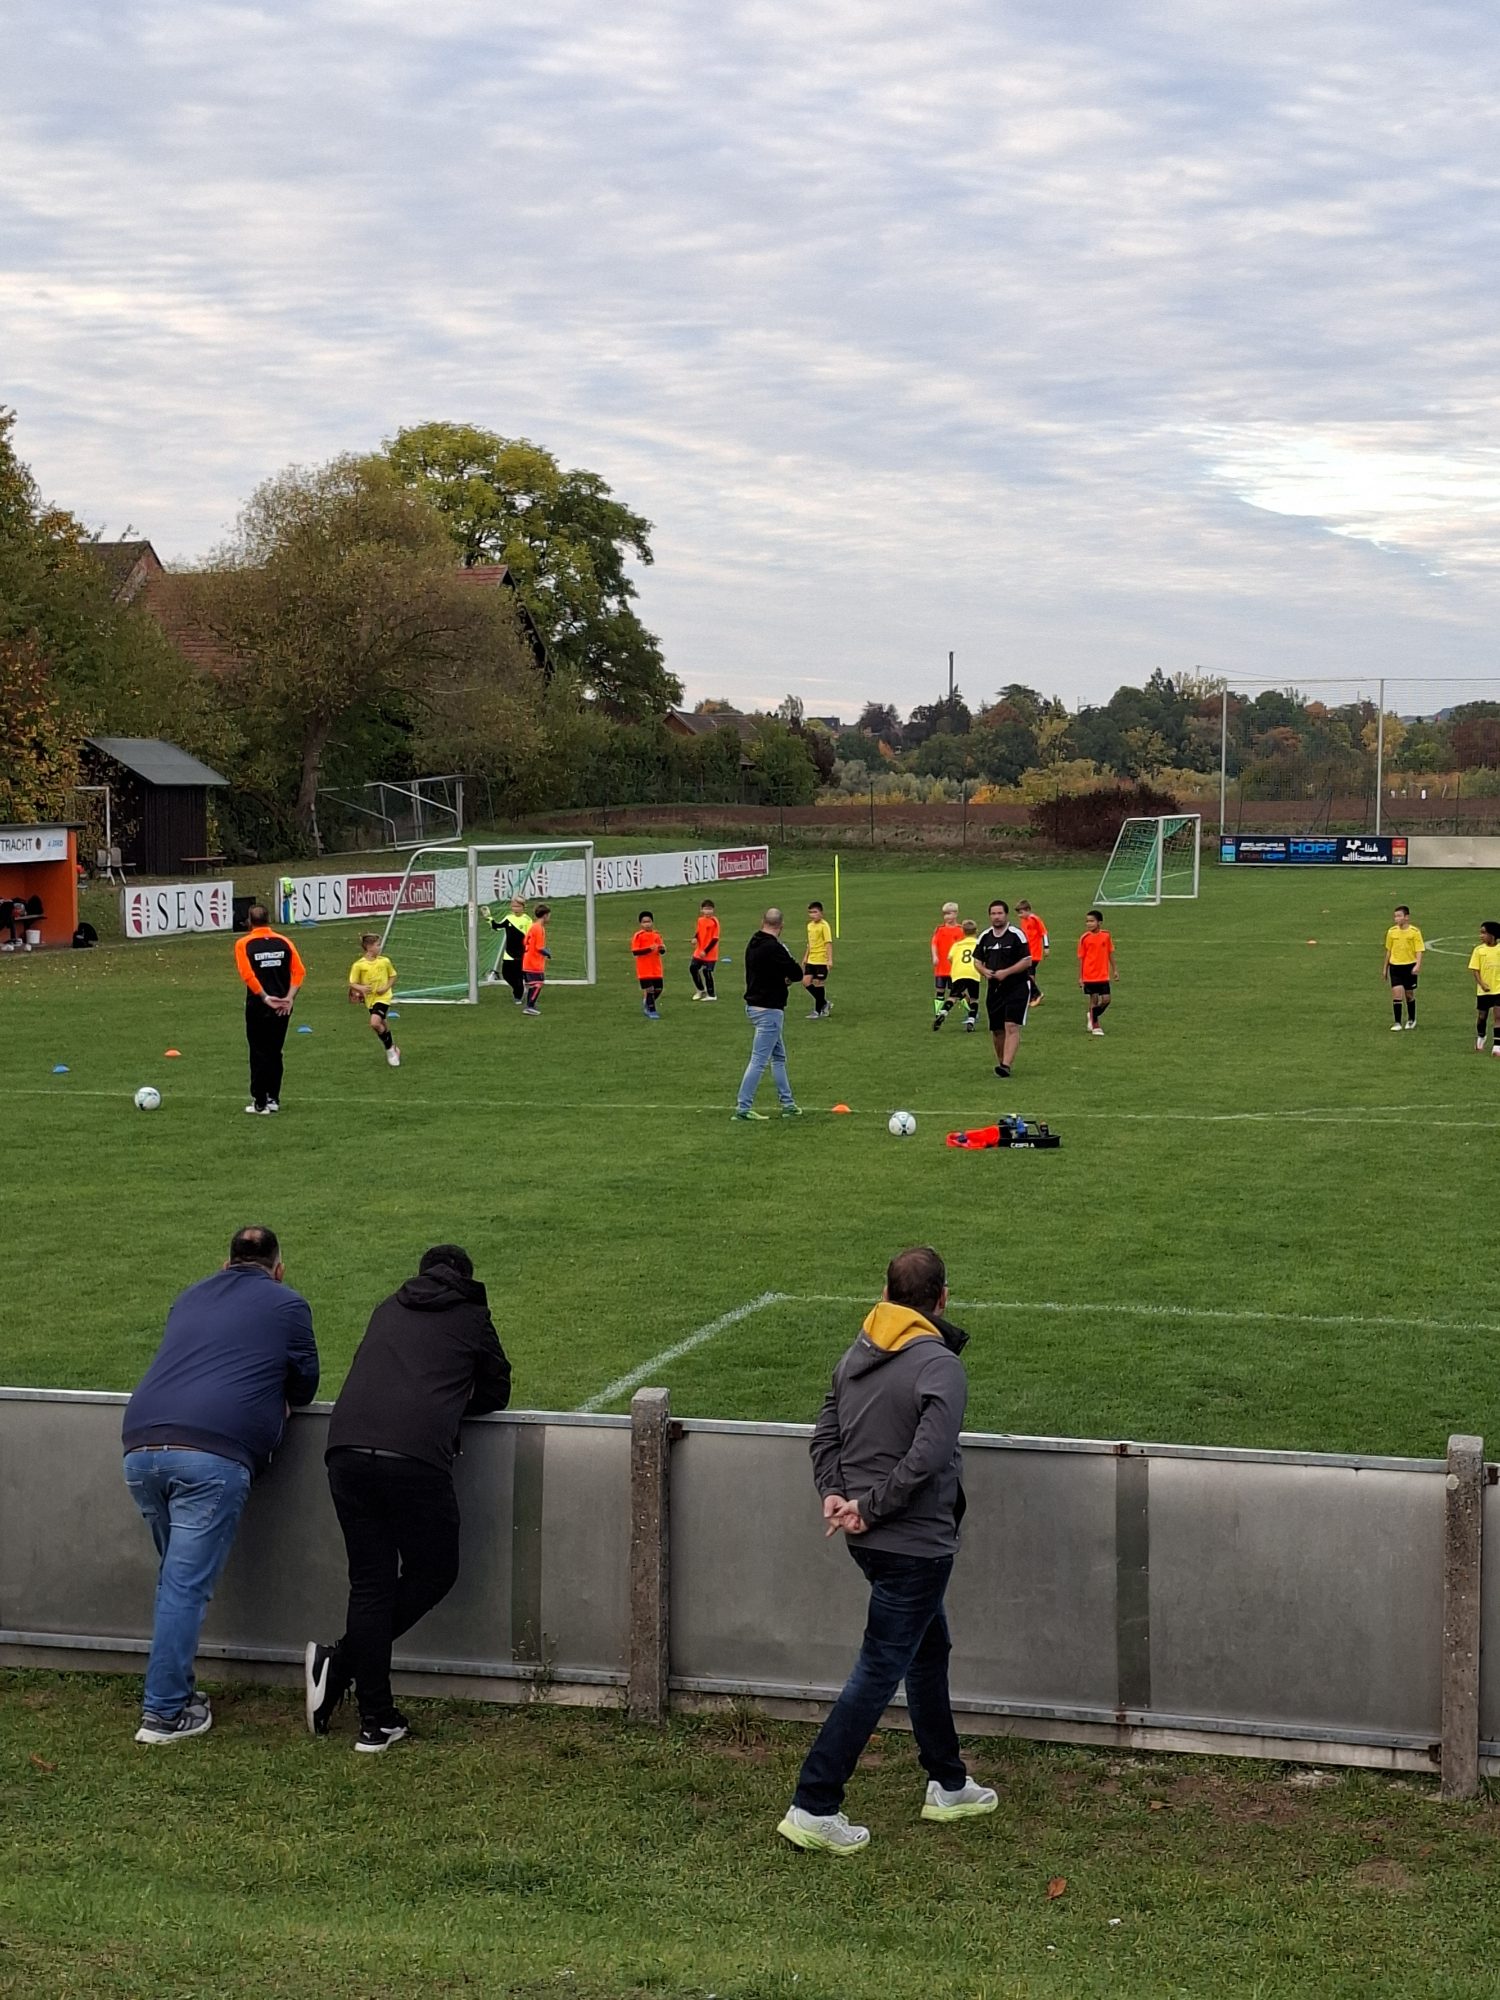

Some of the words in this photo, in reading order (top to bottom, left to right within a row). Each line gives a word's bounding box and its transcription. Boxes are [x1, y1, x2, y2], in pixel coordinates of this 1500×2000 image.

[1290, 843, 1337, 854] HOPF
[607, 859, 633, 889] SES
[694, 853, 716, 881] SES
[157, 890, 204, 931] SES
[302, 880, 343, 918] SES
[349, 883, 407, 908] Elektrotechnk
[409, 881, 434, 904] GmbH
[962, 949, 972, 964] 8
